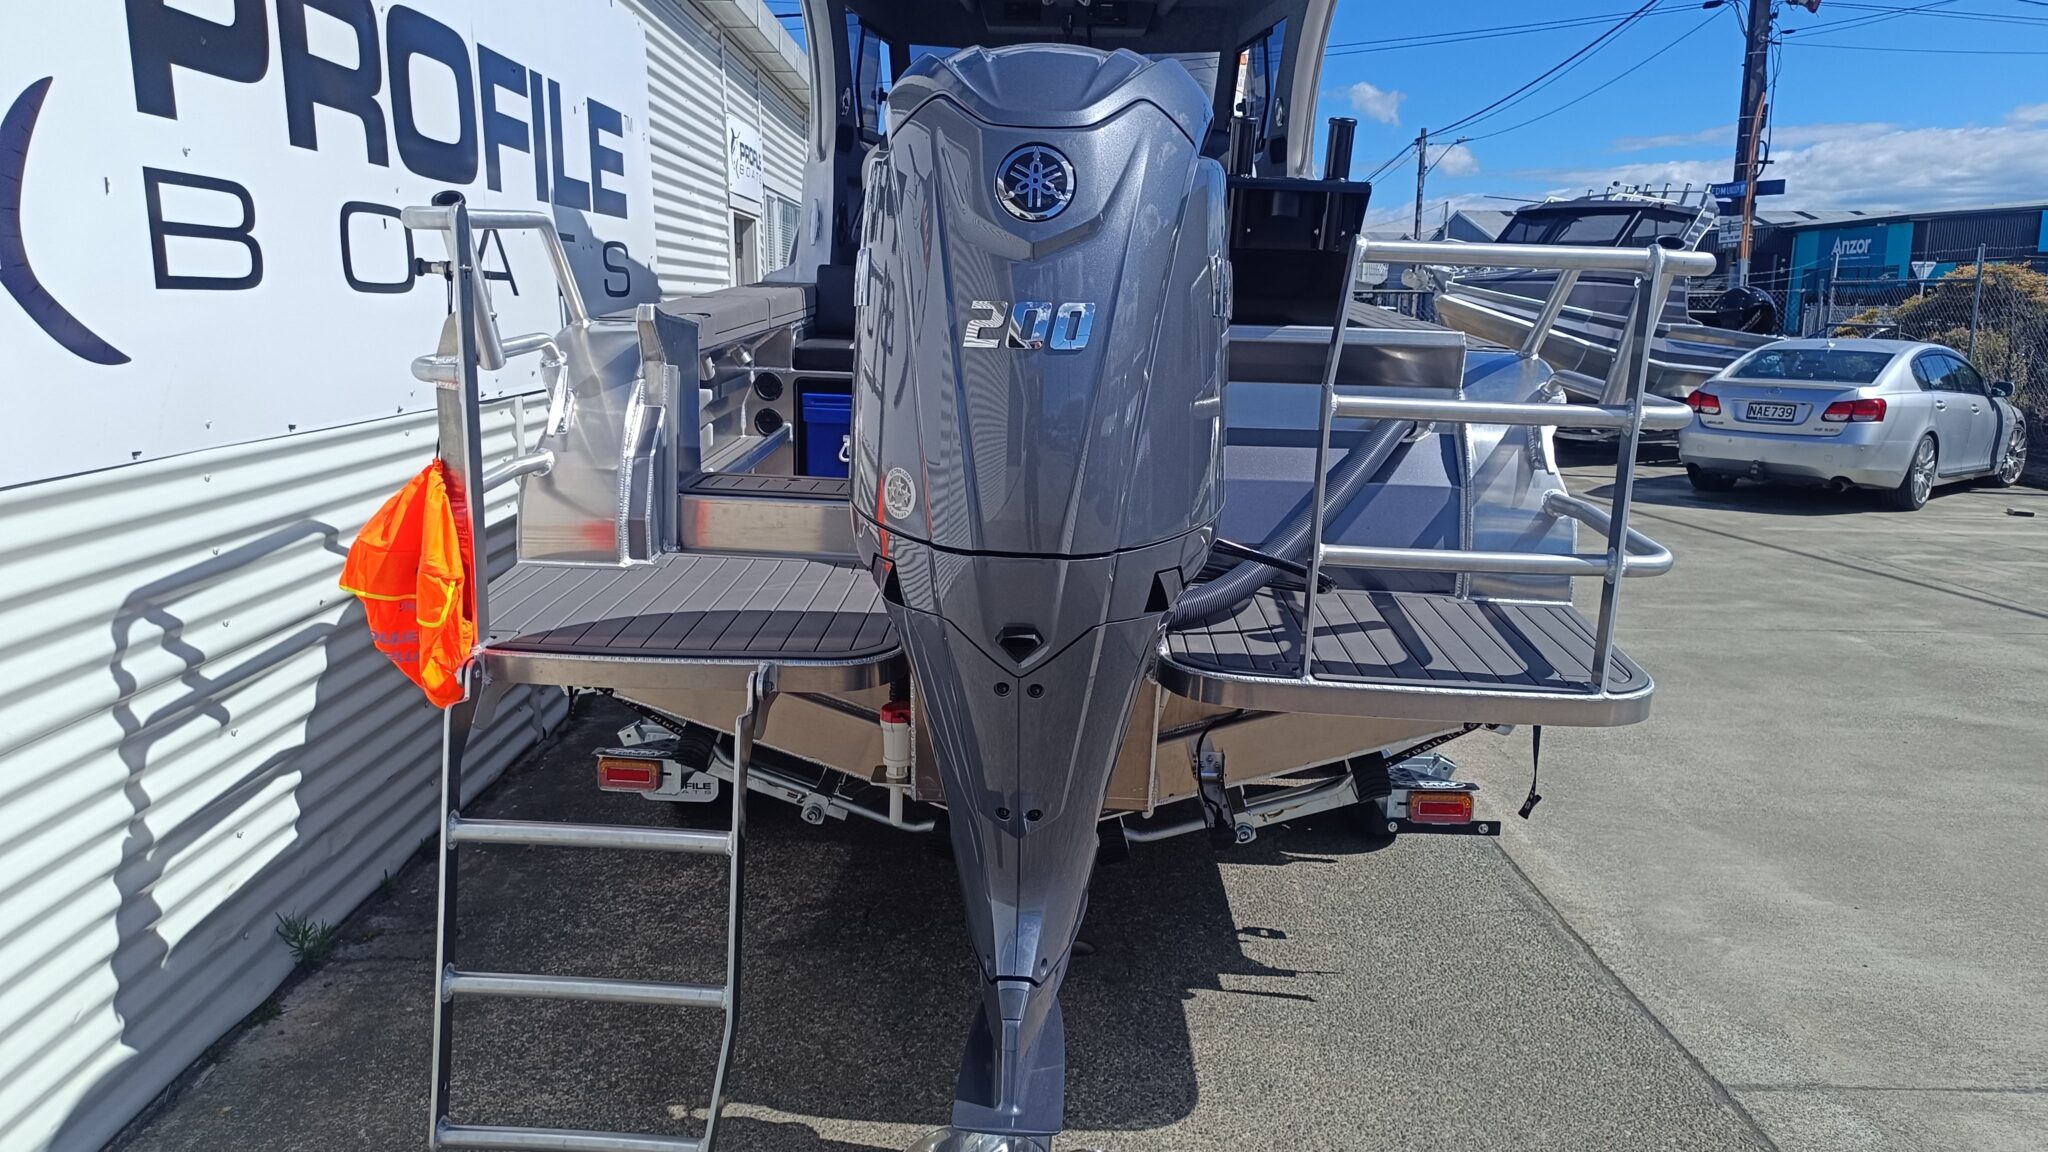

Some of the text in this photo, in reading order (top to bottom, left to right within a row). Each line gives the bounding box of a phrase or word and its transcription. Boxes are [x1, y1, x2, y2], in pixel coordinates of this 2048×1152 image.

[125, 0, 628, 219] PROFILE
[1831, 236, 1872, 255] Anzor
[963, 300, 1096, 350] 200
[1749, 405, 1793, 418] NAE739
